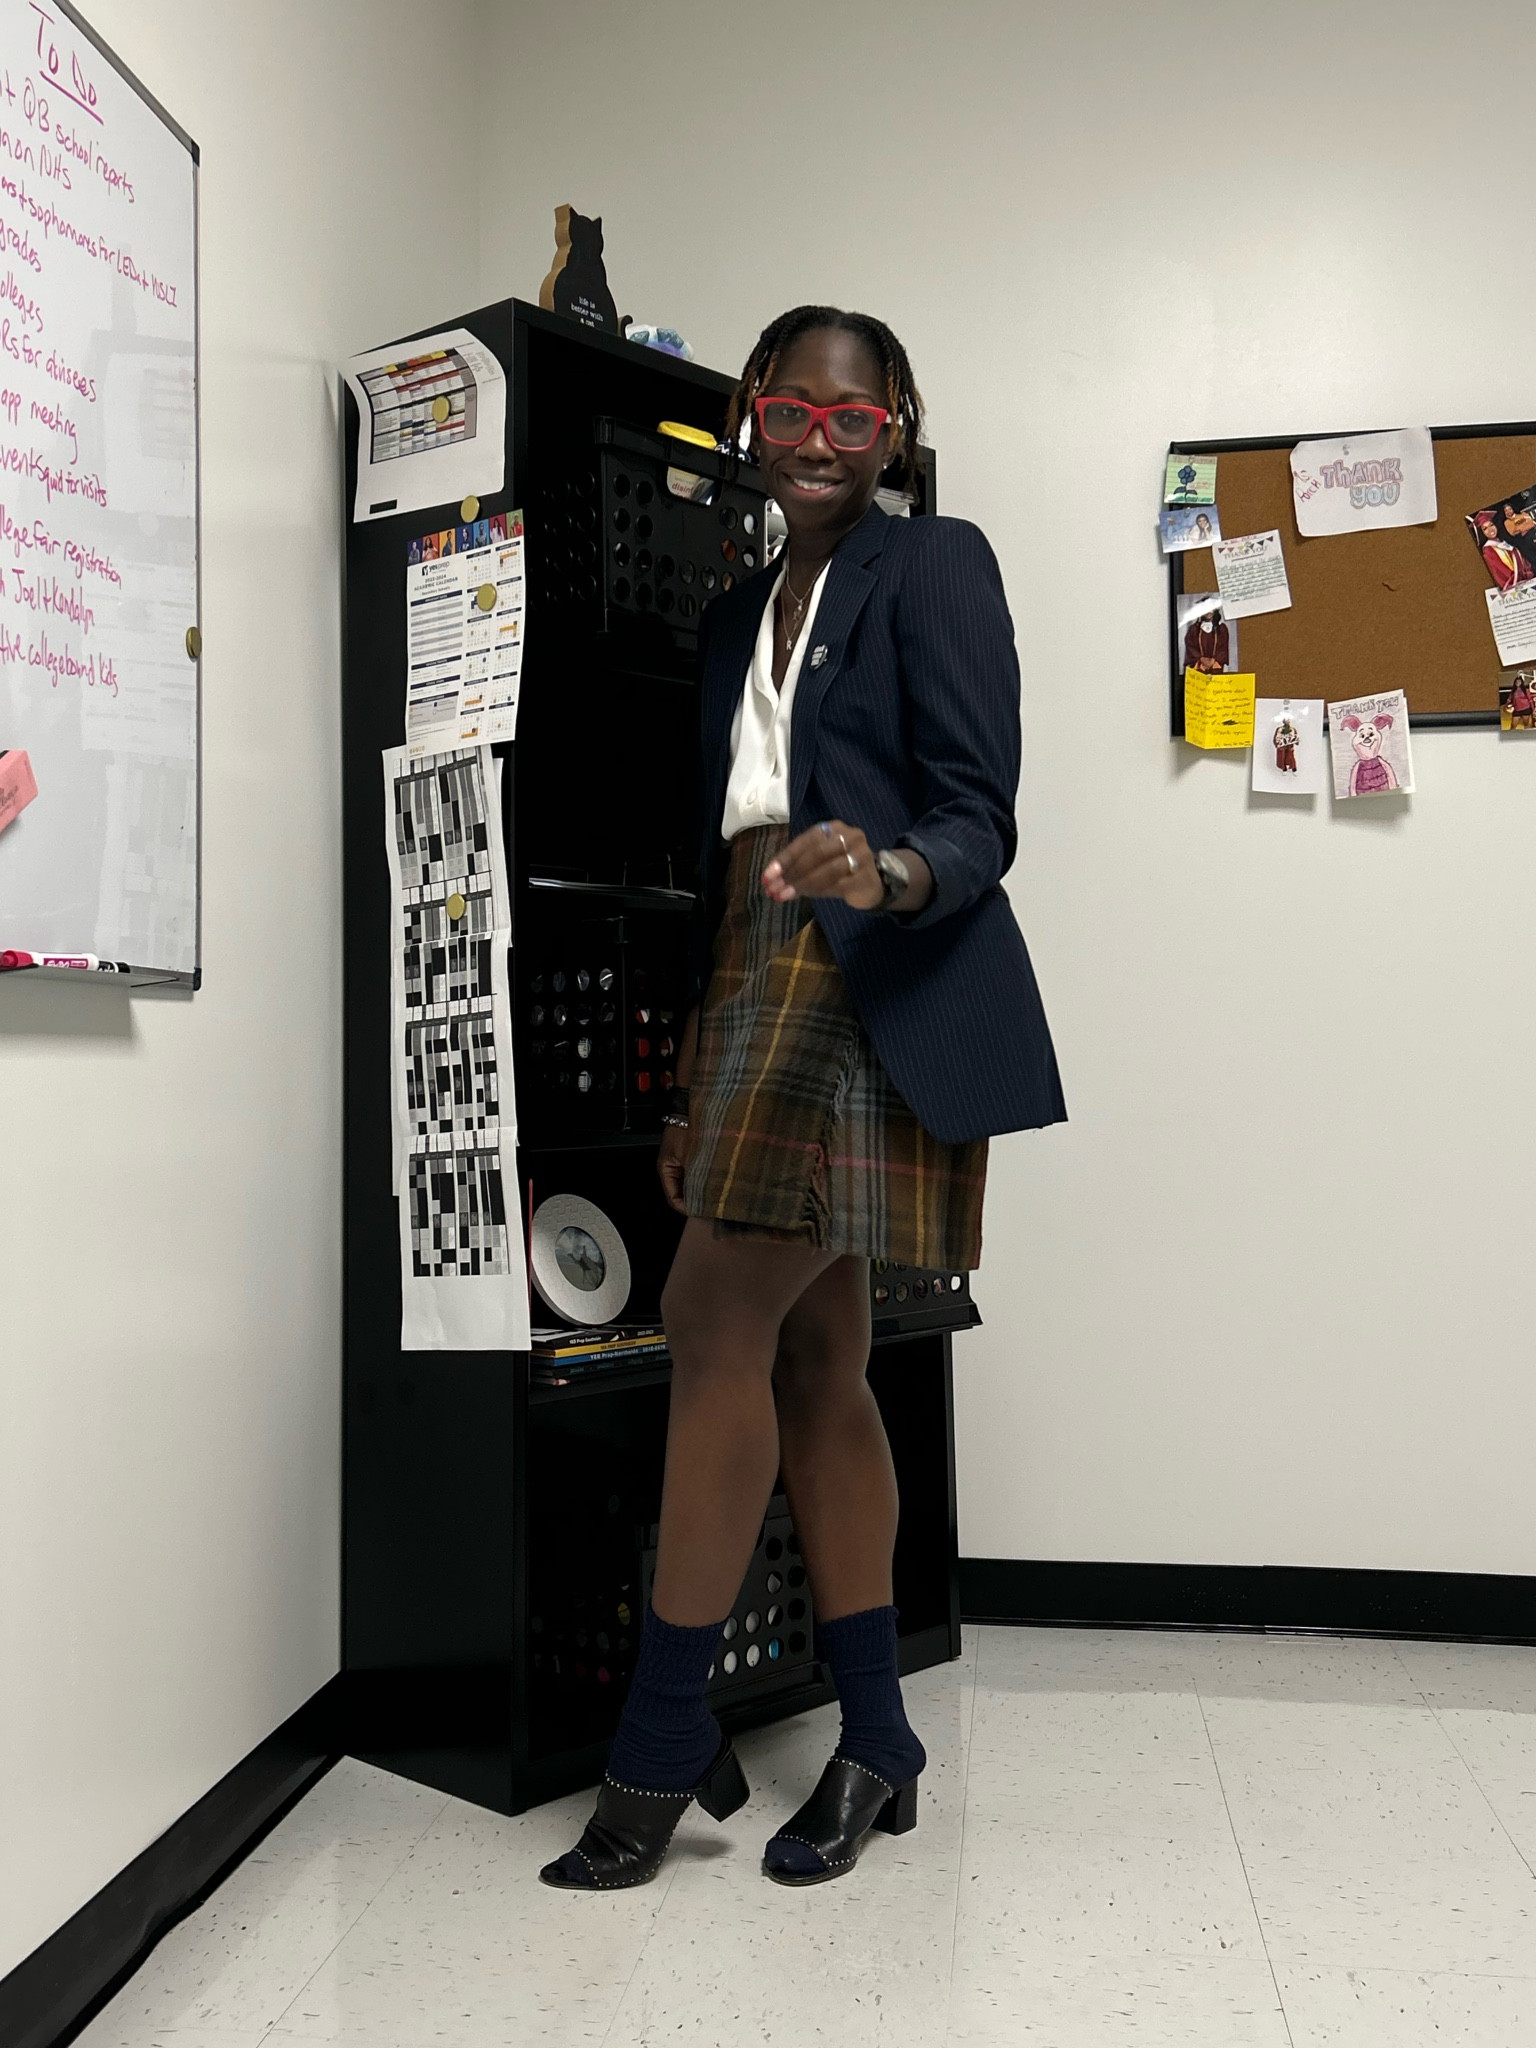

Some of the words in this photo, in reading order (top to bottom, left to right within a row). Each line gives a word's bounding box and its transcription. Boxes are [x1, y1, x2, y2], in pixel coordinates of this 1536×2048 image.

[28, 1, 59, 75] To
[71, 50, 98, 107] Do
[14, 138, 35, 172] on
[39, 143, 72, 190] NHS
[23, 76, 50, 133] QB
[55, 123, 92, 171] school
[96, 154, 136, 203] reports
[22, 333, 43, 370] for
[30, 400, 78, 465] meeting
[33, 519, 62, 556] fair
[63, 540, 122, 591] registration
[12, 567, 41, 612] Joel
[99, 651, 119, 699] kids
